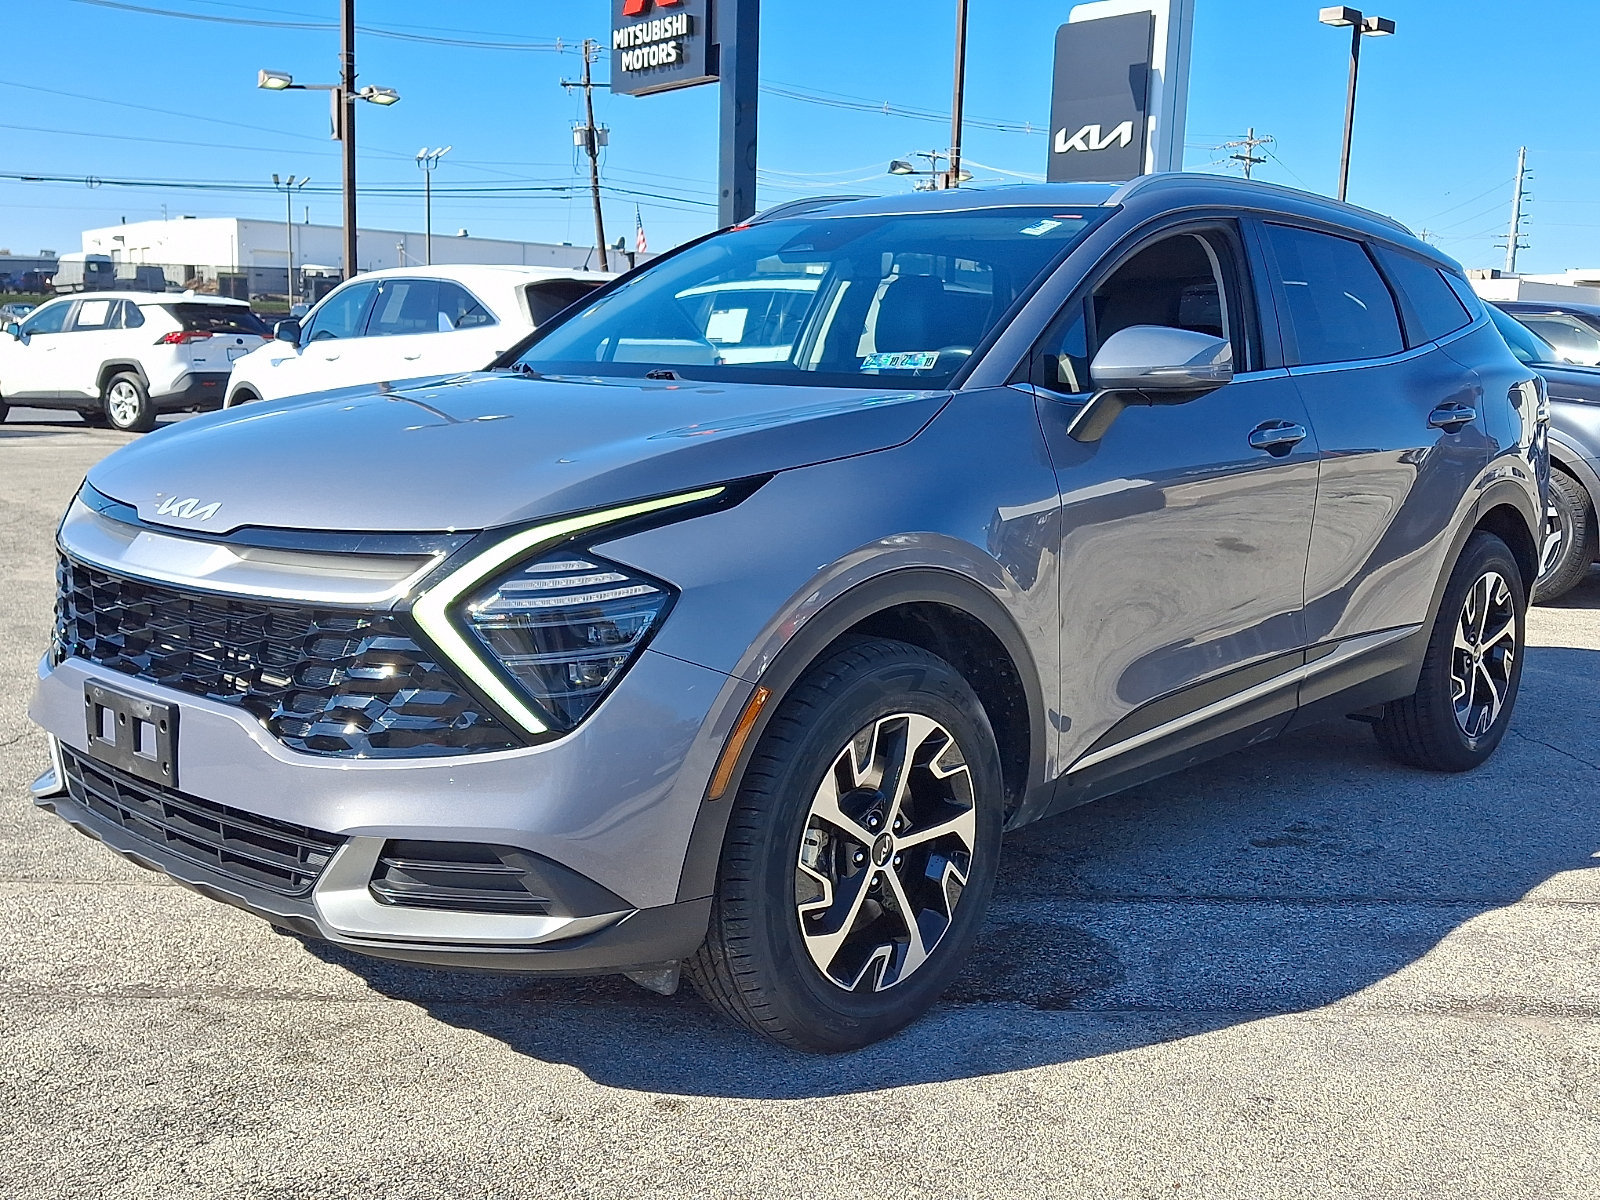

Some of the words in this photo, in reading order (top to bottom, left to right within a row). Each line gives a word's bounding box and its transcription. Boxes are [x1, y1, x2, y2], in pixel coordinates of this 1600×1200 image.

[613, 13, 688, 50] MITSUBISHI
[621, 40, 677, 72] MOTORS
[1054, 120, 1133, 153] KIA
[156, 496, 223, 522] KIA
